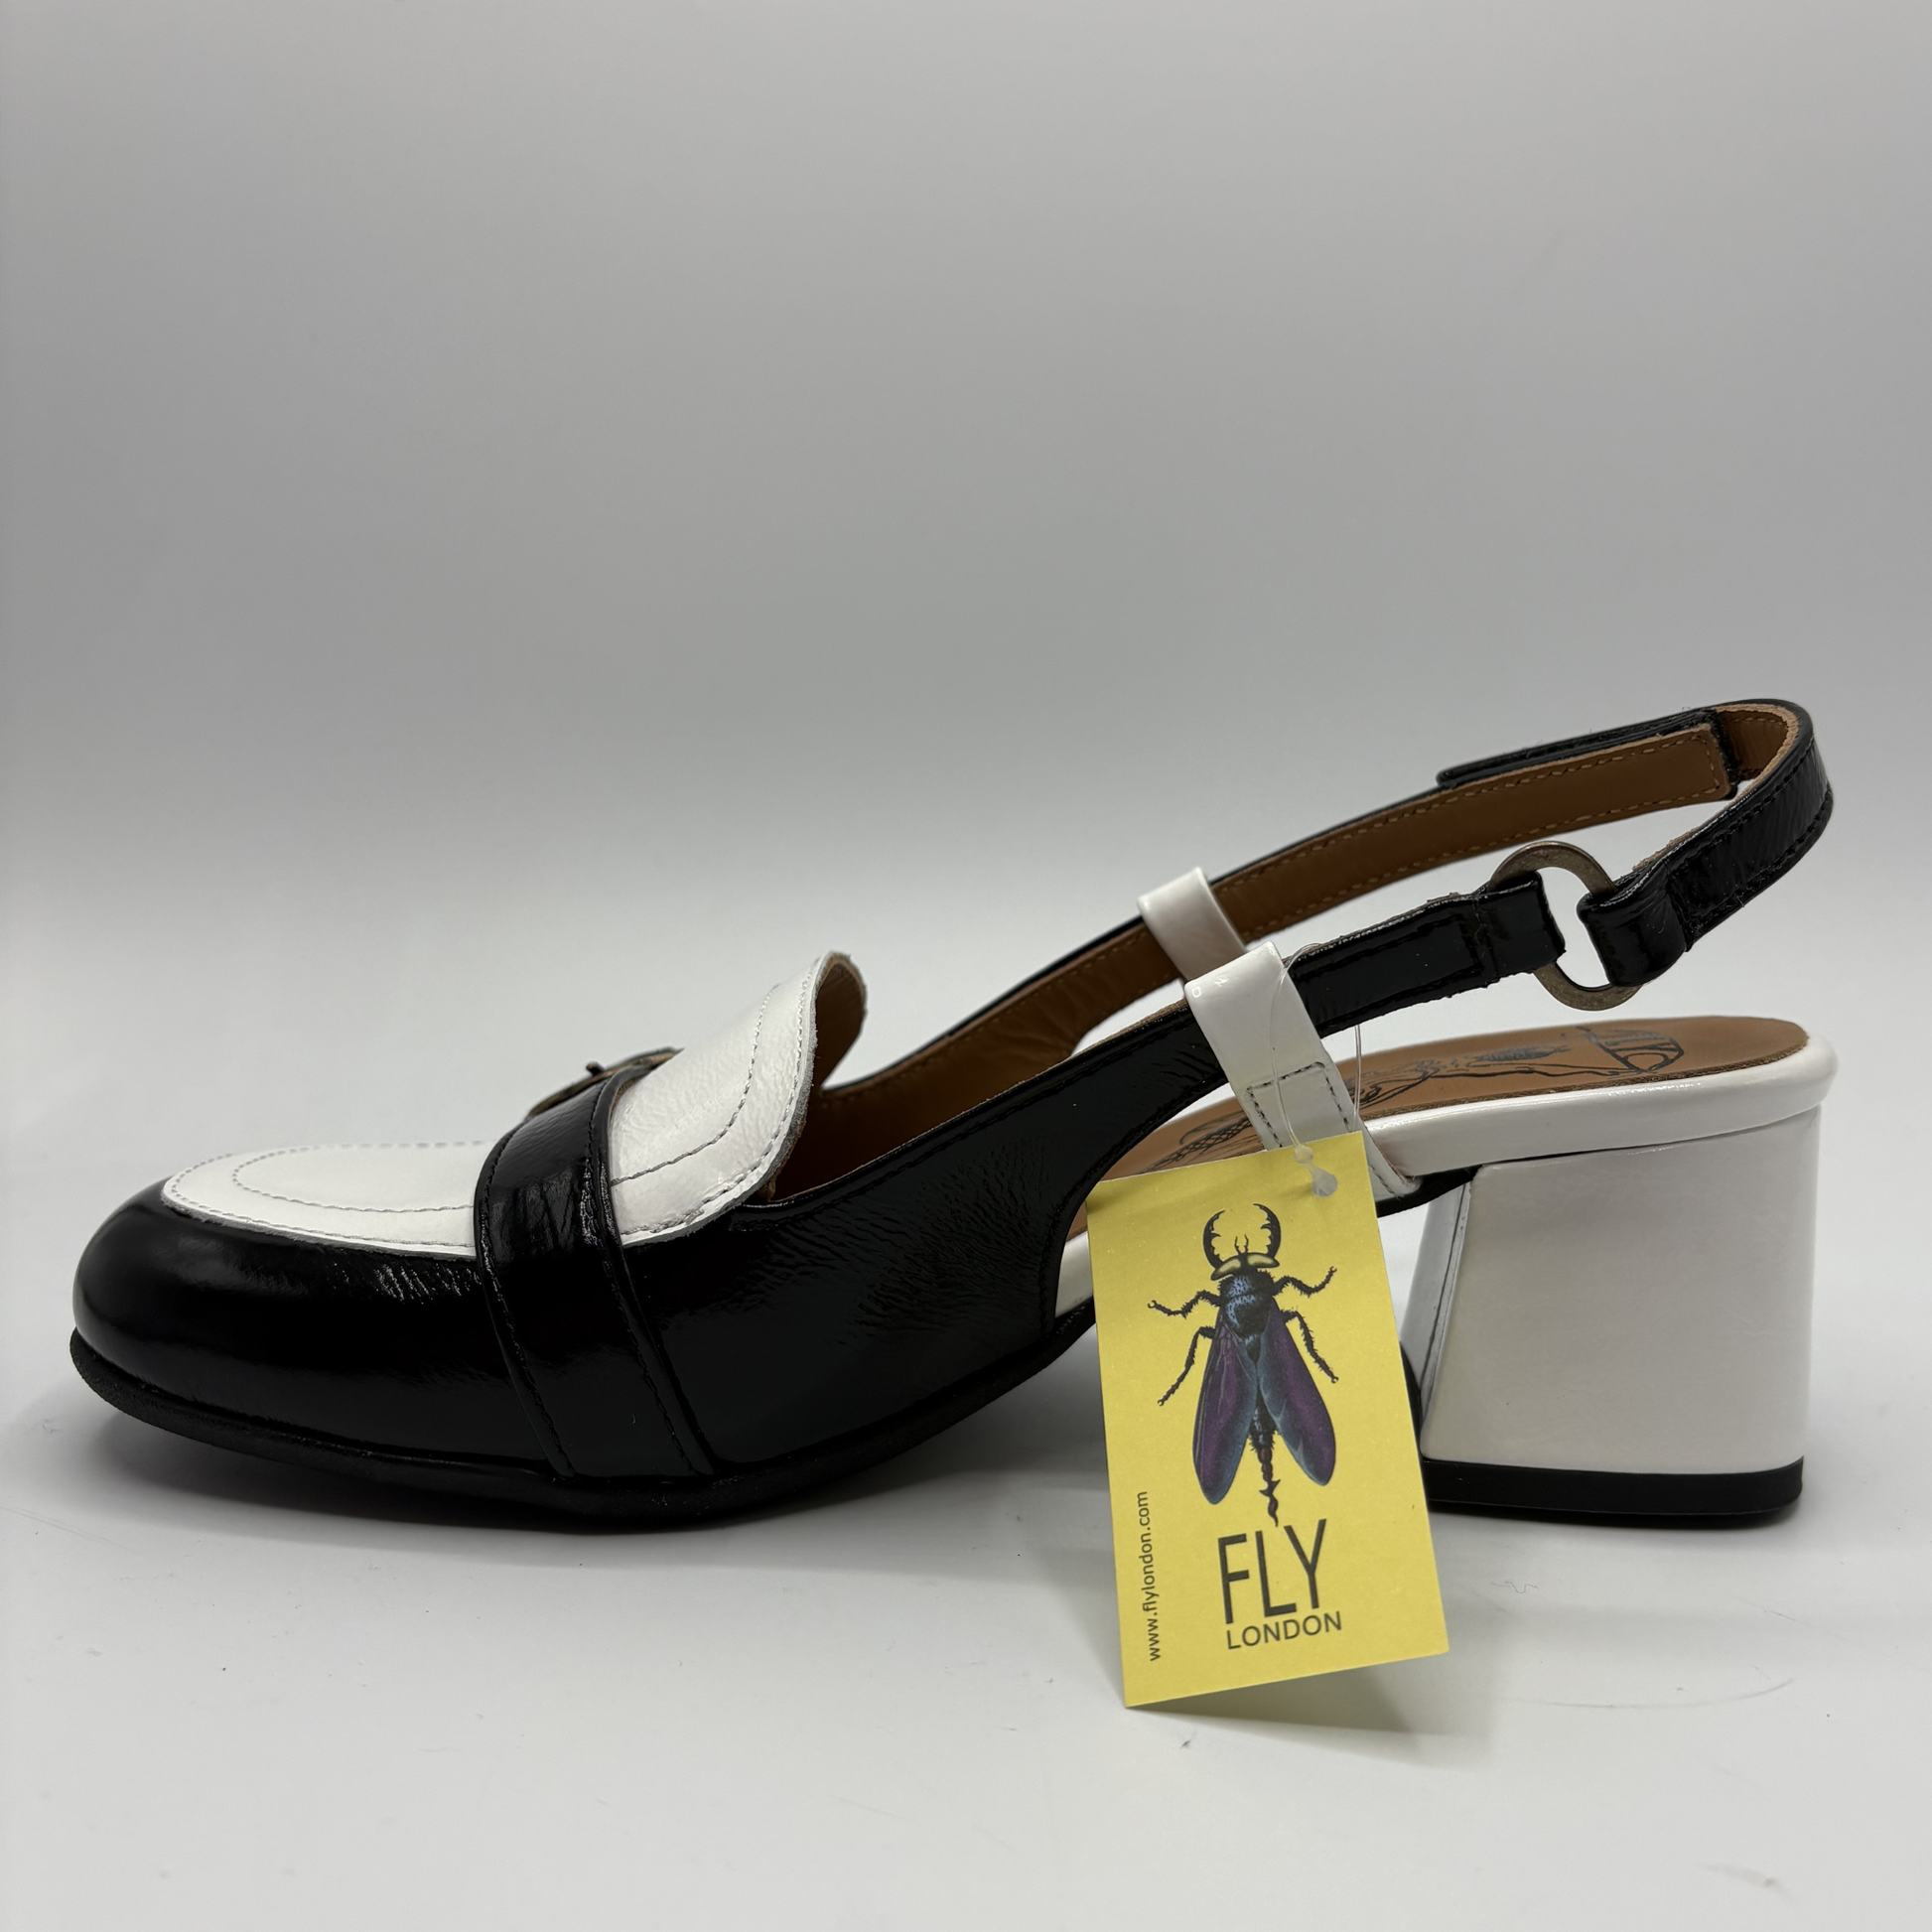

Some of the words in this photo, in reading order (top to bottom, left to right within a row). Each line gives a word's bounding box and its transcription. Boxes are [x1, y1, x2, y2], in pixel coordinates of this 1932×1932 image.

[1137, 1490, 1161, 1662] www.flylondon.com
[1217, 1518, 1327, 1624] FLY
[1226, 1610, 1342, 1650] LONDON
